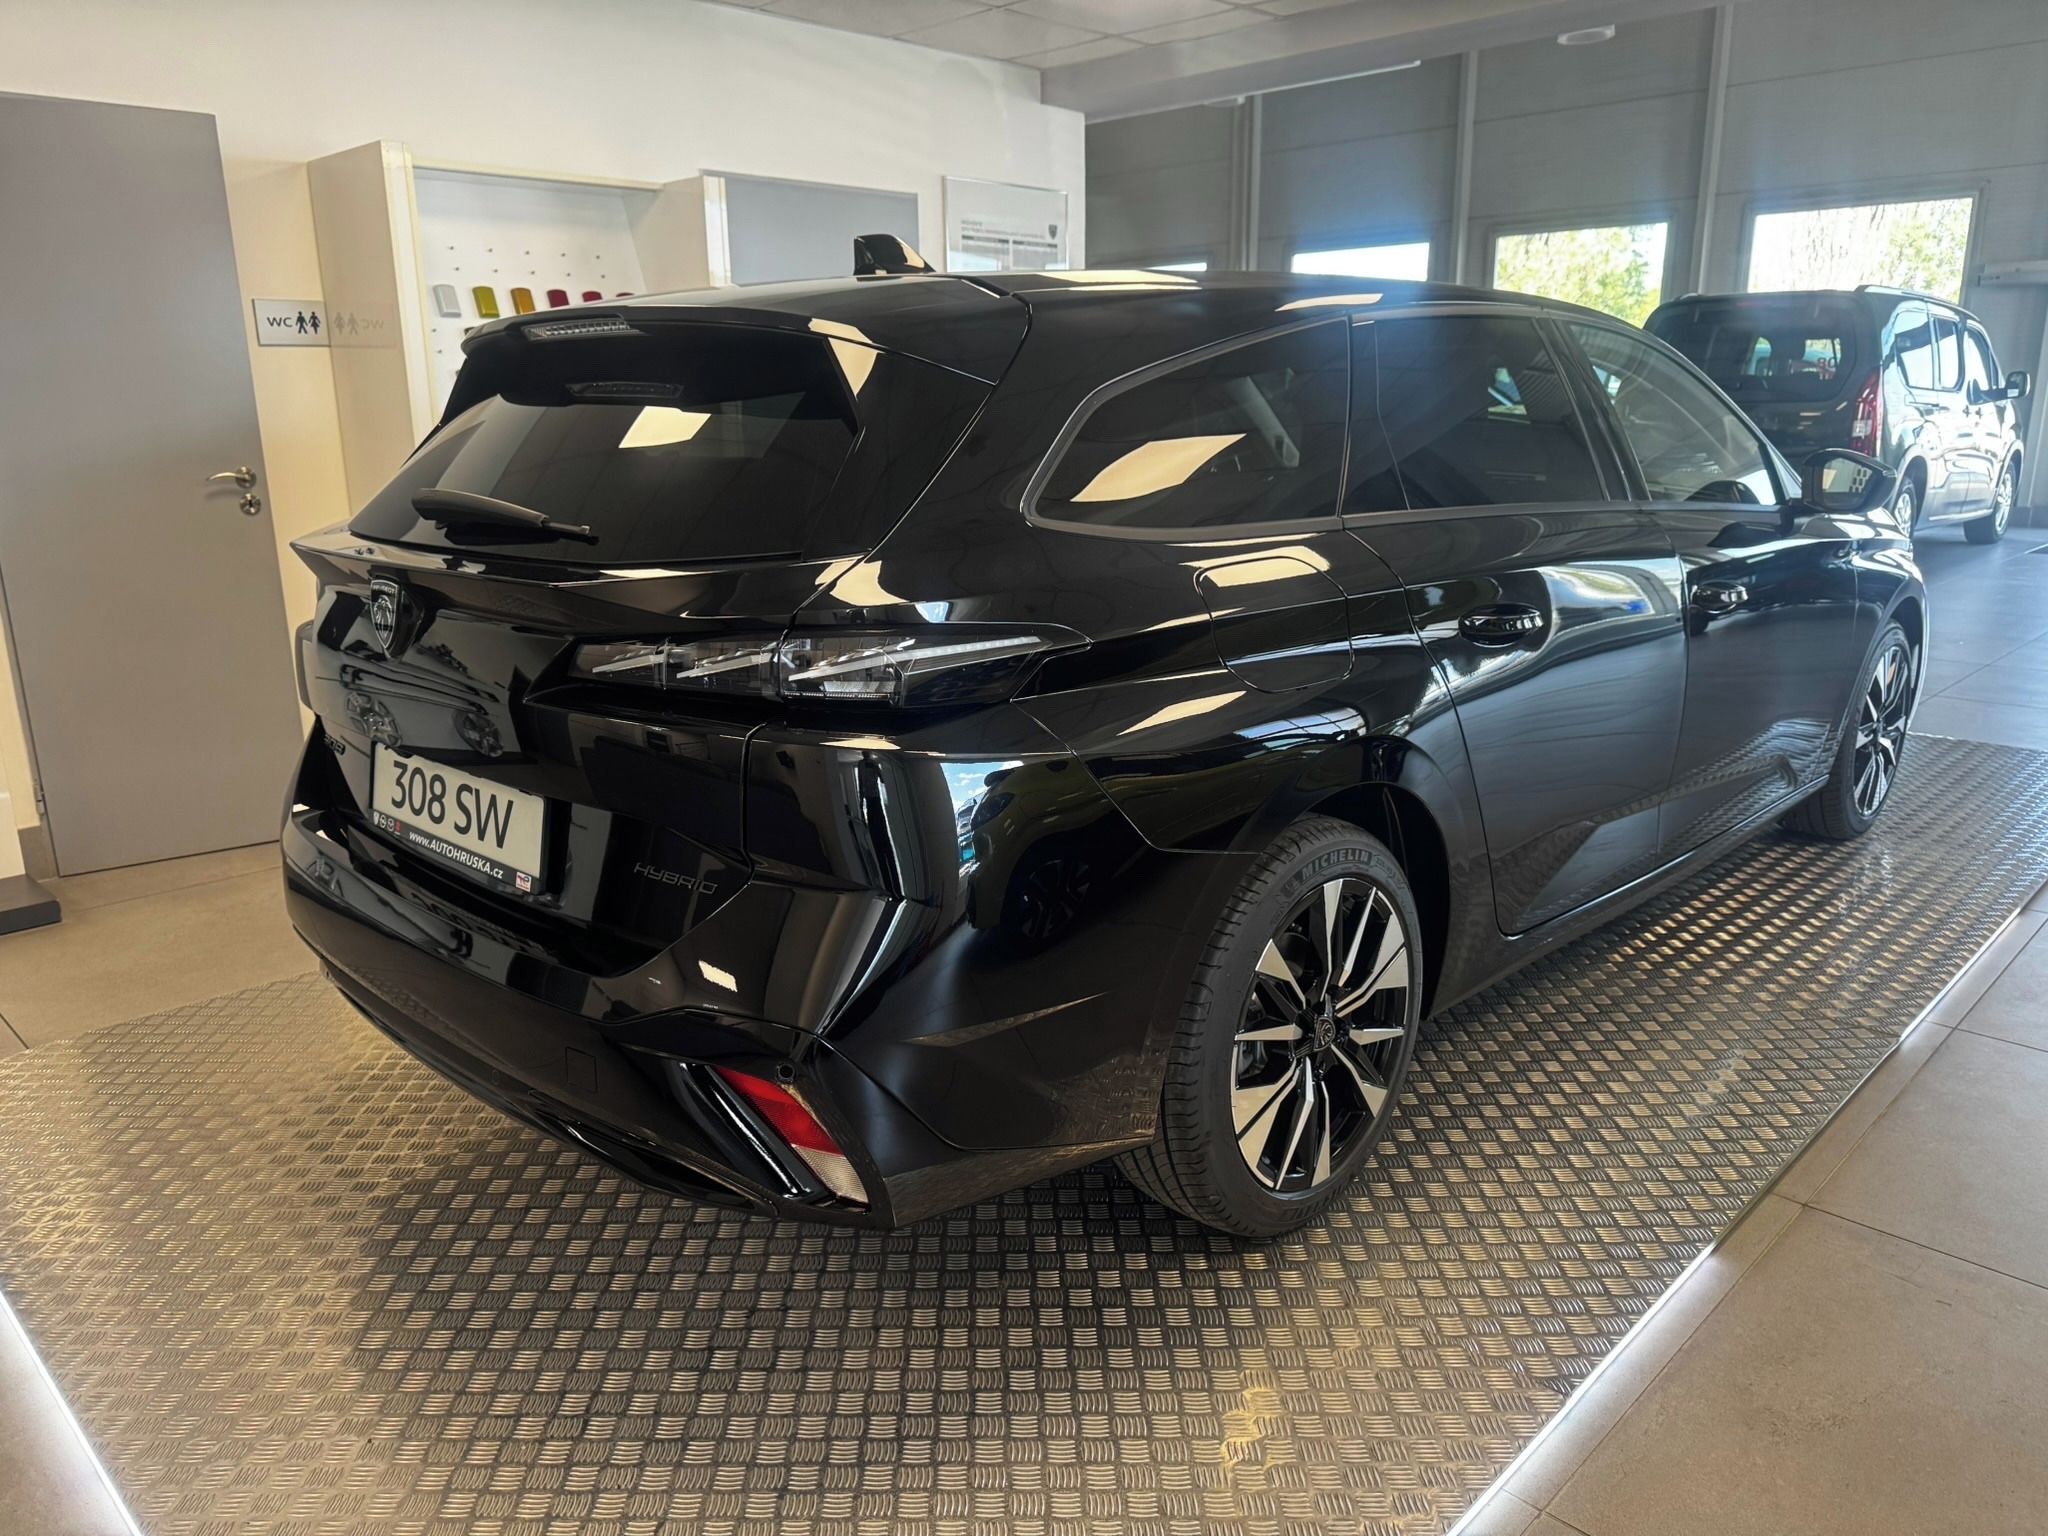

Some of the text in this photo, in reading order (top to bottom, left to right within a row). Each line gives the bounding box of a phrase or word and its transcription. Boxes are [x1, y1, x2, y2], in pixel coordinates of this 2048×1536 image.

[266, 316, 293, 328] WC
[373, 584, 395, 594] PEEOT
[391, 760, 514, 849] 308 SW
[409, 831, 504, 879] www.AUTOHRUSKA.cz
[1301, 850, 1370, 880] MICHELIN
[633, 862, 718, 894] HYBRID
